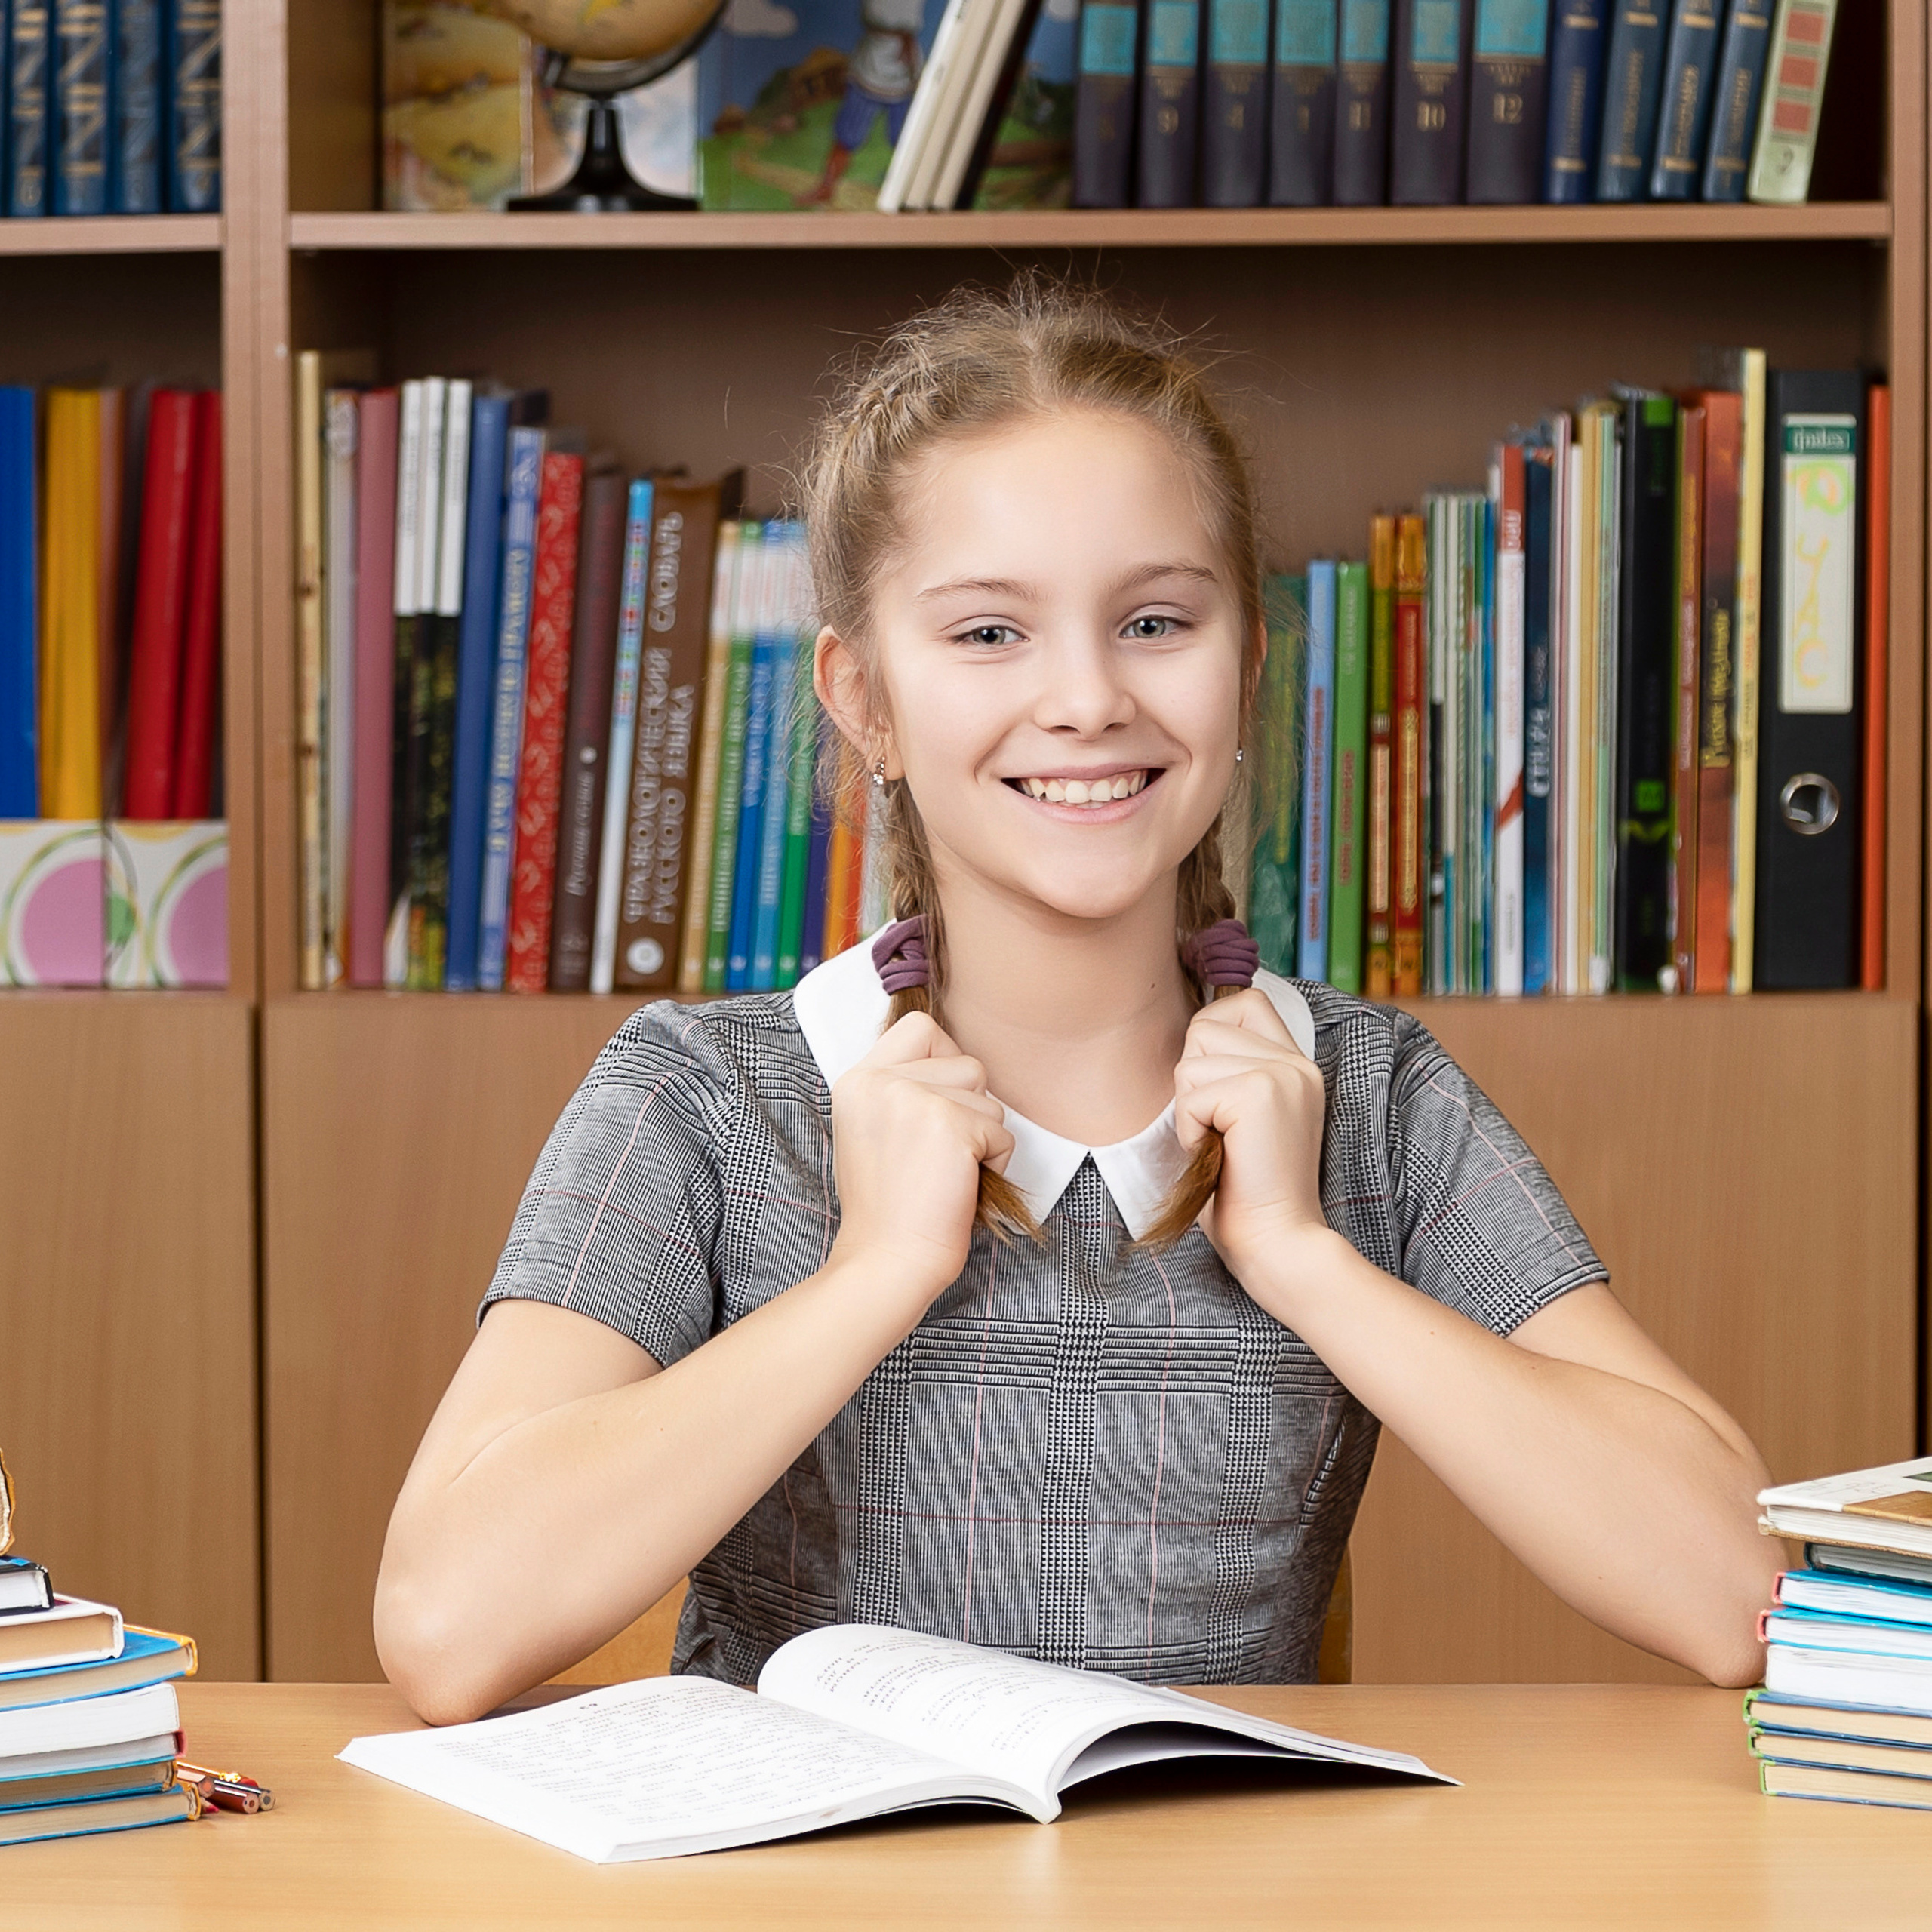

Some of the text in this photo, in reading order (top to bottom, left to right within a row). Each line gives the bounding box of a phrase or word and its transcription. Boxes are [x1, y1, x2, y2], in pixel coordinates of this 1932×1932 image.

[1492, 92, 1523, 125] 12
[648, 511, 684, 632] СЛОВАРЬ
[649, 684, 694, 924] РУССКОГО ЯЗЫКА
